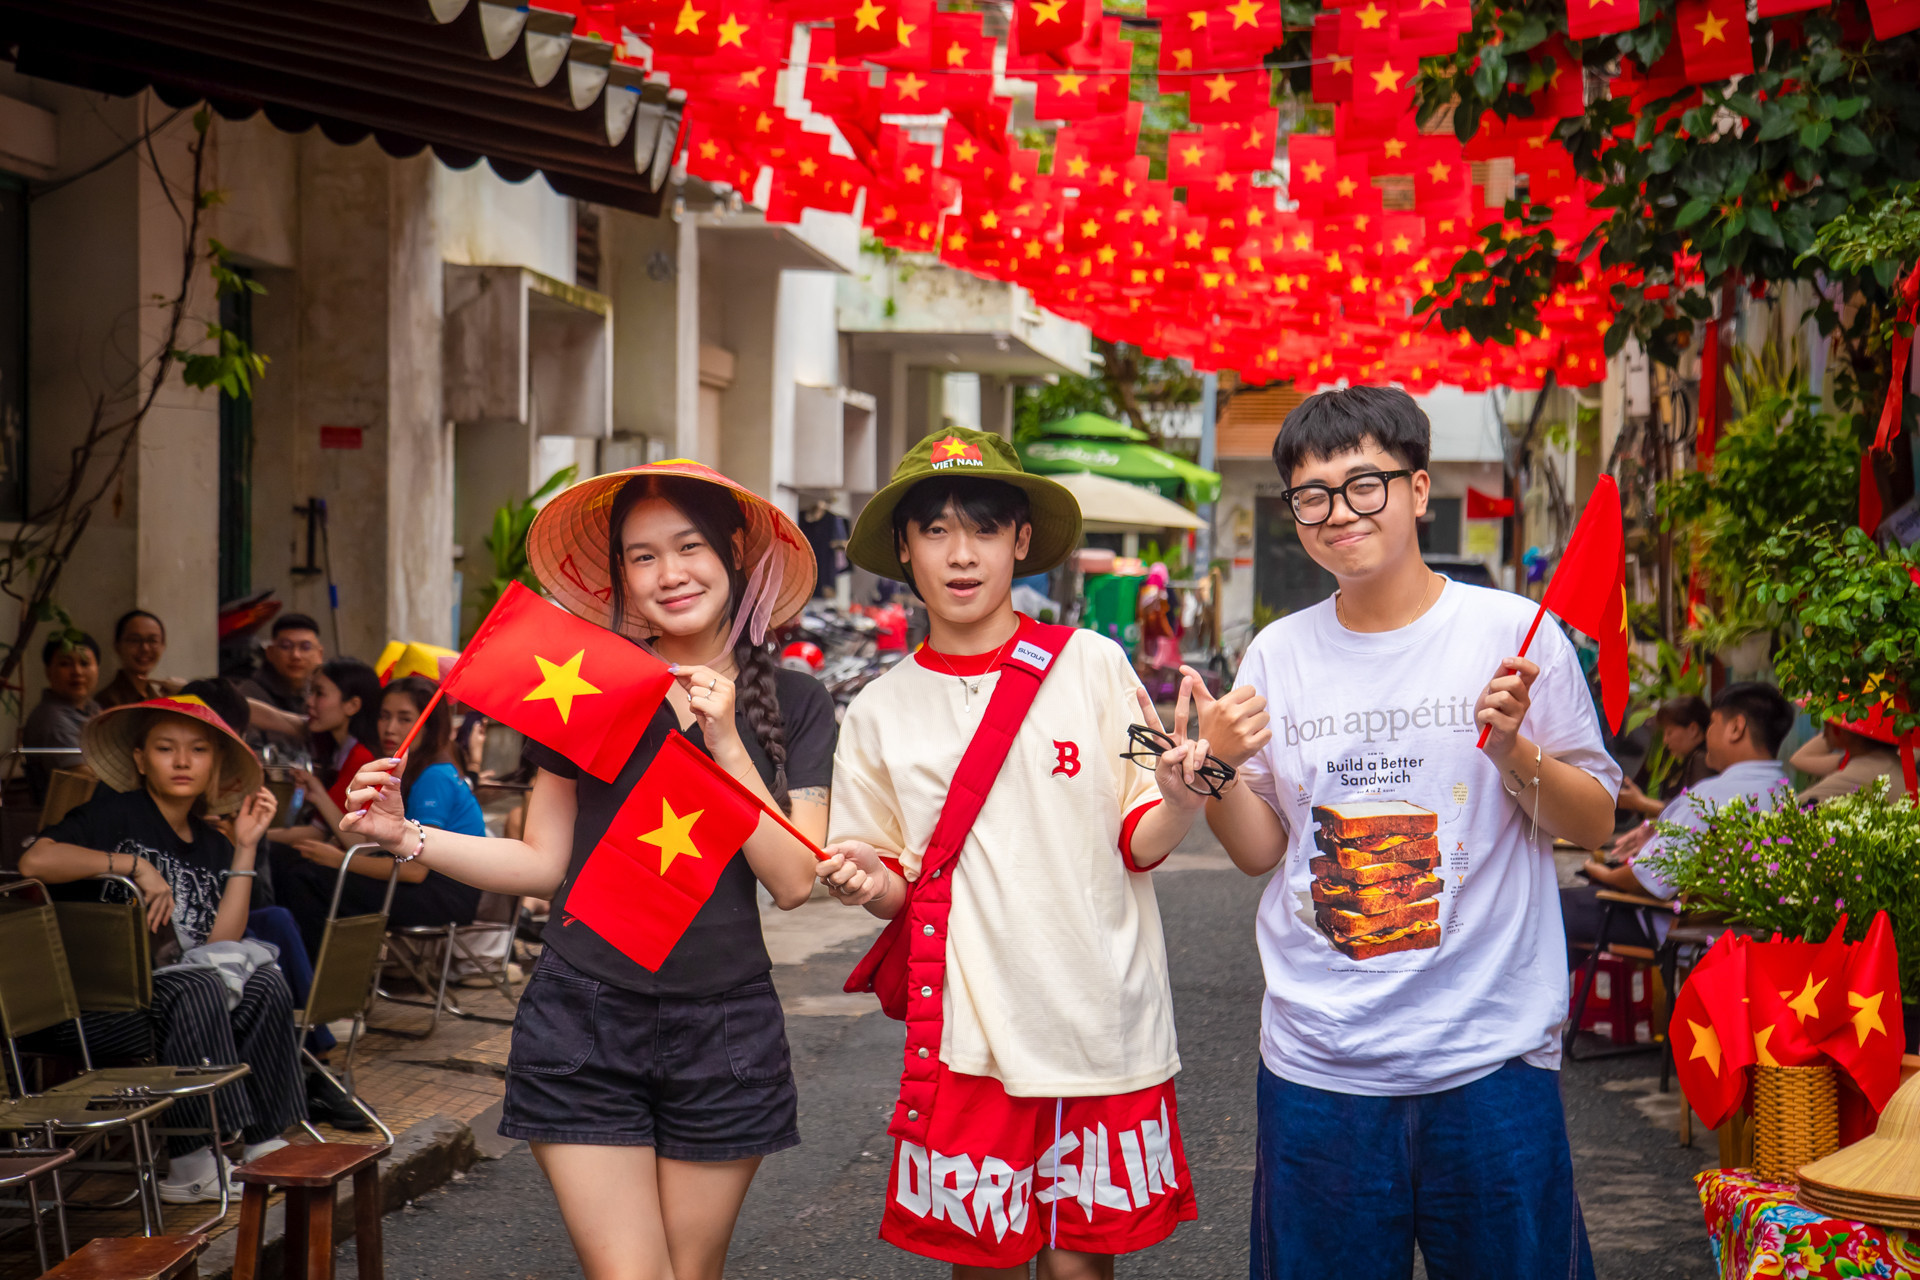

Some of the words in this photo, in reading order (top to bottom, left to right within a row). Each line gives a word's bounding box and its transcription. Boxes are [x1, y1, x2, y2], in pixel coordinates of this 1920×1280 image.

[931, 459, 954, 470] VIET
[956, 458, 984, 467] NAM
[1281, 715, 1337, 747] bon
[1343, 696, 1474, 743] appétit
[1051, 739, 1082, 779] B
[1327, 758, 1363, 773] Build
[1367, 761, 1377, 771] a
[1381, 757, 1424, 770] Better
[1341, 770, 1411, 786] Sandwich
[1456, 841, 1464, 851] X
[1457, 874, 1464, 884] Y
